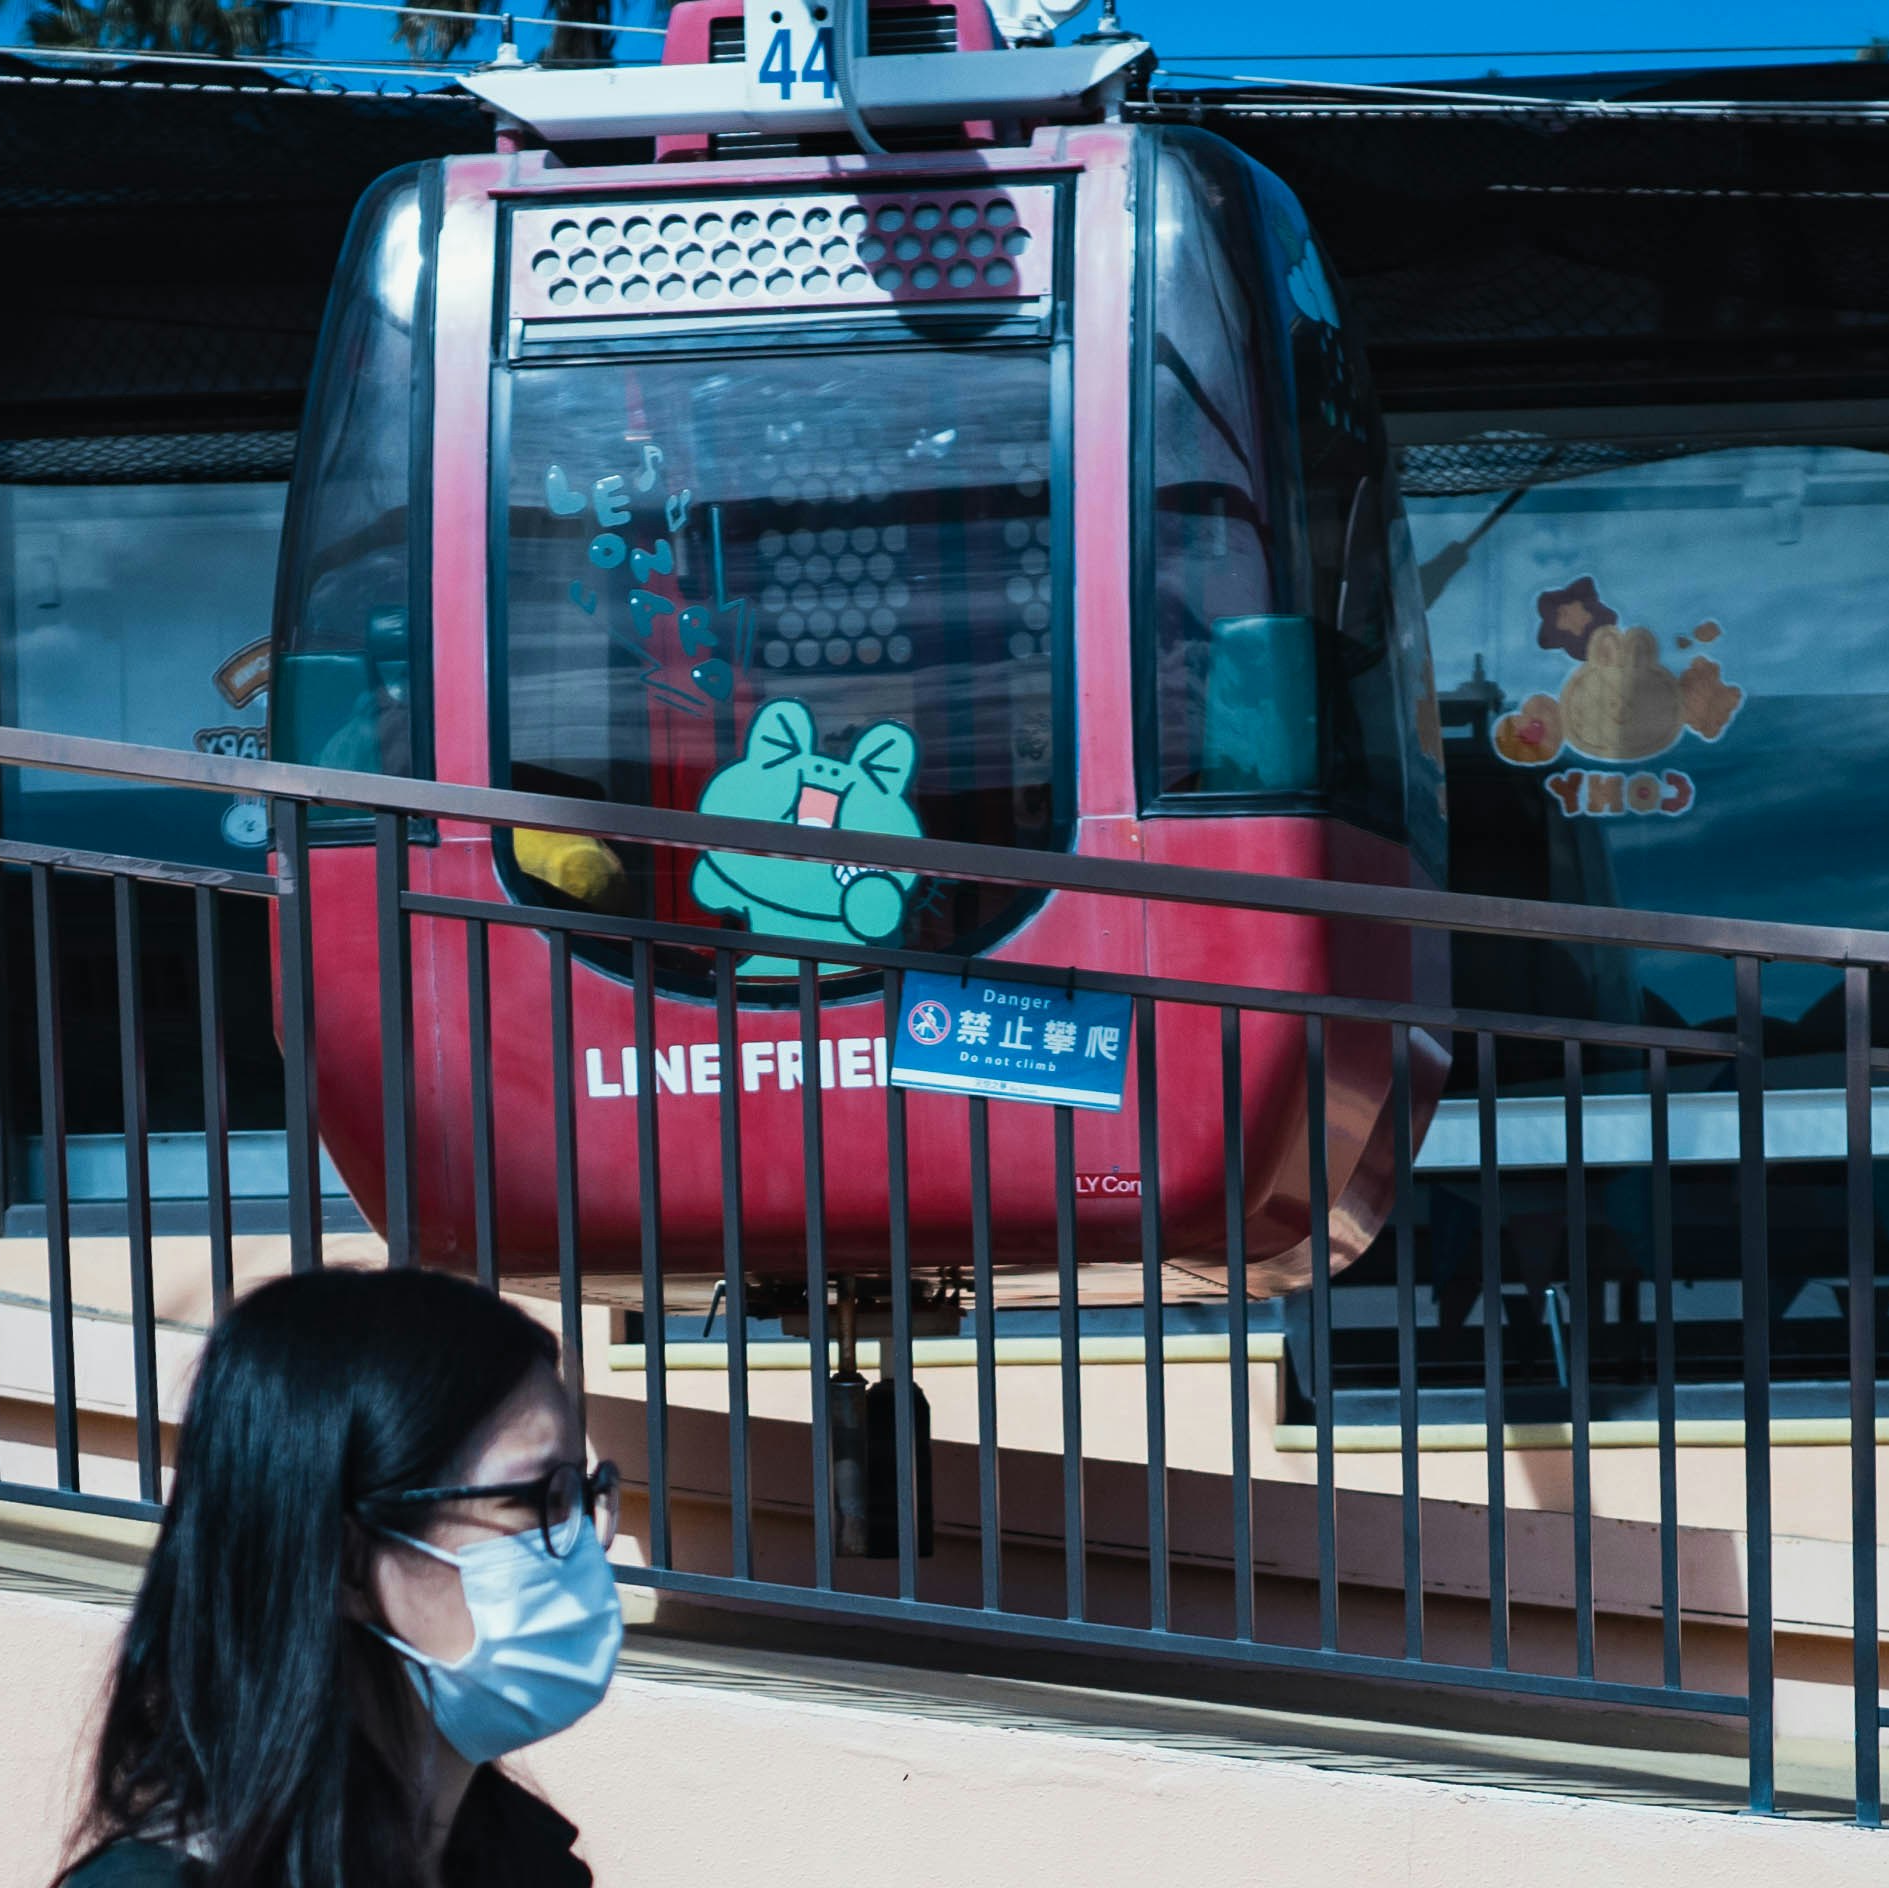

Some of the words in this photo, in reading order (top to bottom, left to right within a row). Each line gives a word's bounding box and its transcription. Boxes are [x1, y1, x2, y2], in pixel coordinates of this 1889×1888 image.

[758, 27, 836, 100] 44
[983, 988, 1052, 1011] Danger
[956, 1009, 1121, 1061] 禁止攀爬
[585, 1043, 721, 1098] LINE
[959, 1051, 979, 1063] Do
[984, 1055, 1010, 1067] not
[1015, 1056, 1057, 1072] climb
[1075, 1176, 1100, 1193] LY
